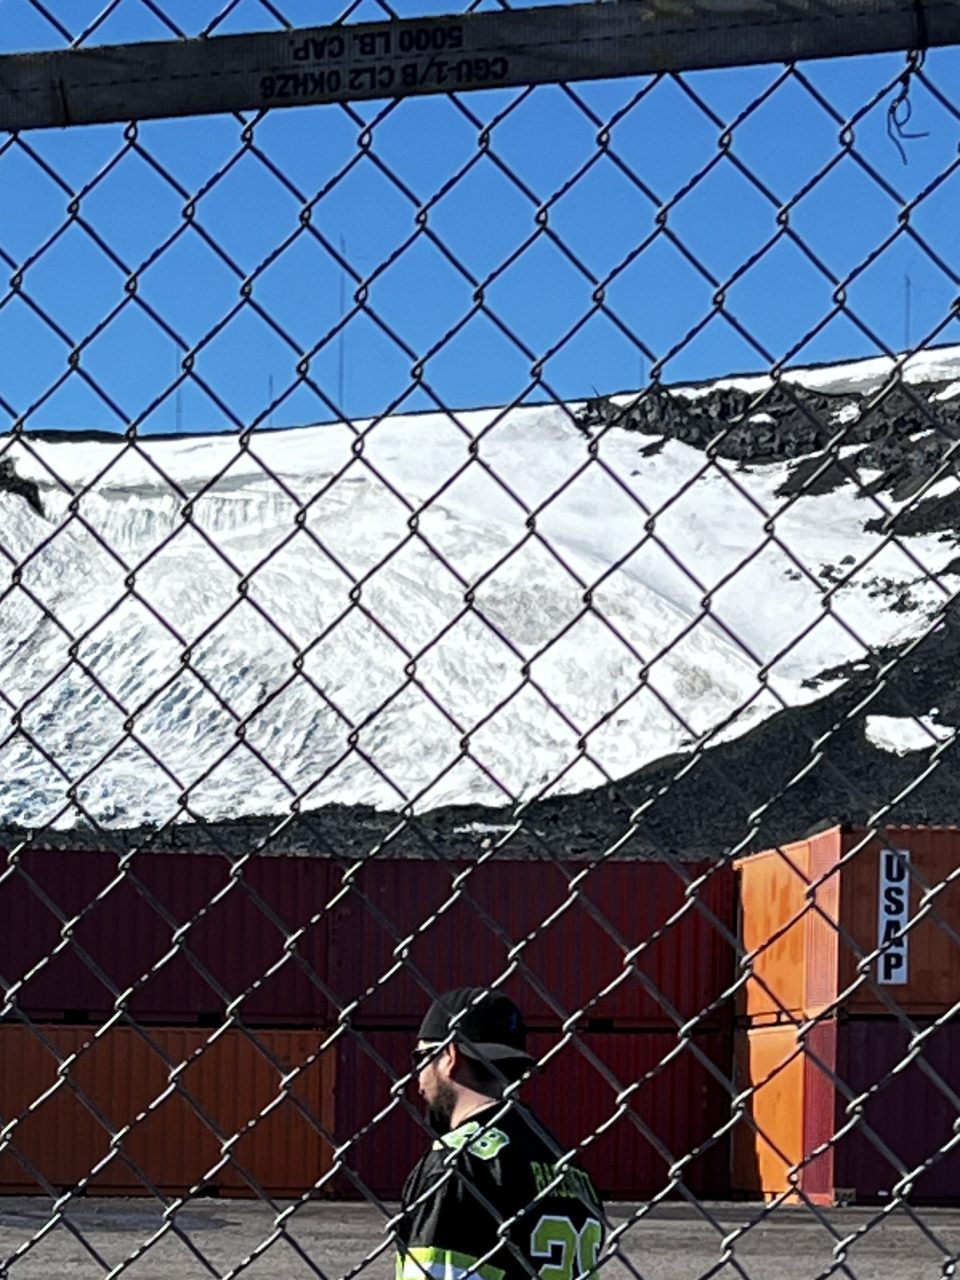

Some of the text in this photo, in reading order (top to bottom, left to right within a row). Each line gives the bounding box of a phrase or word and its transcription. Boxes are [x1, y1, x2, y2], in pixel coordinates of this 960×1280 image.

[289, 26, 463, 61] 5000 LB. CAP.
[349, 65, 395, 90] CL2
[401, 57, 508, 87] CGU-1/B
[883, 854, 906, 980] USAP
